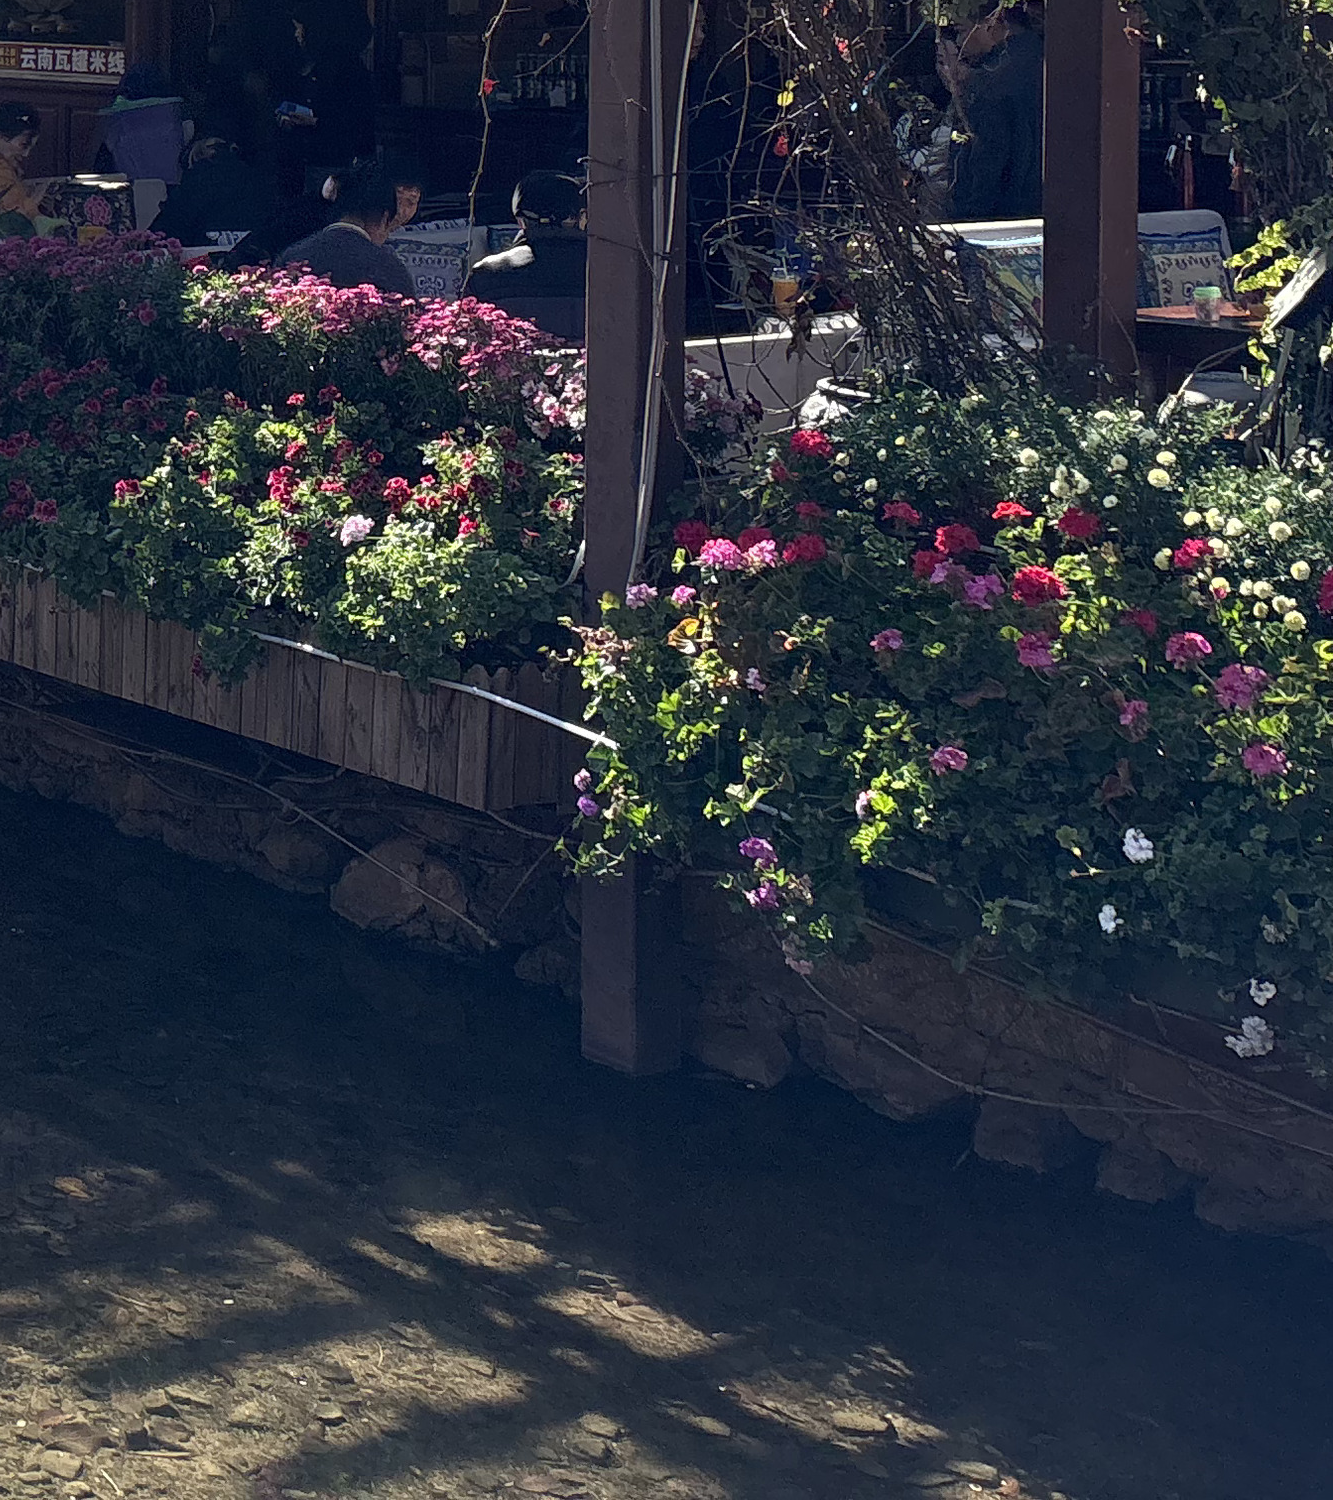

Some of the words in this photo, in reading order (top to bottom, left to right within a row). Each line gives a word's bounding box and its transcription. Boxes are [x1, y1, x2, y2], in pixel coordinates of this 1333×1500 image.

[20, 47, 126, 75] 云南瓦罐米线
